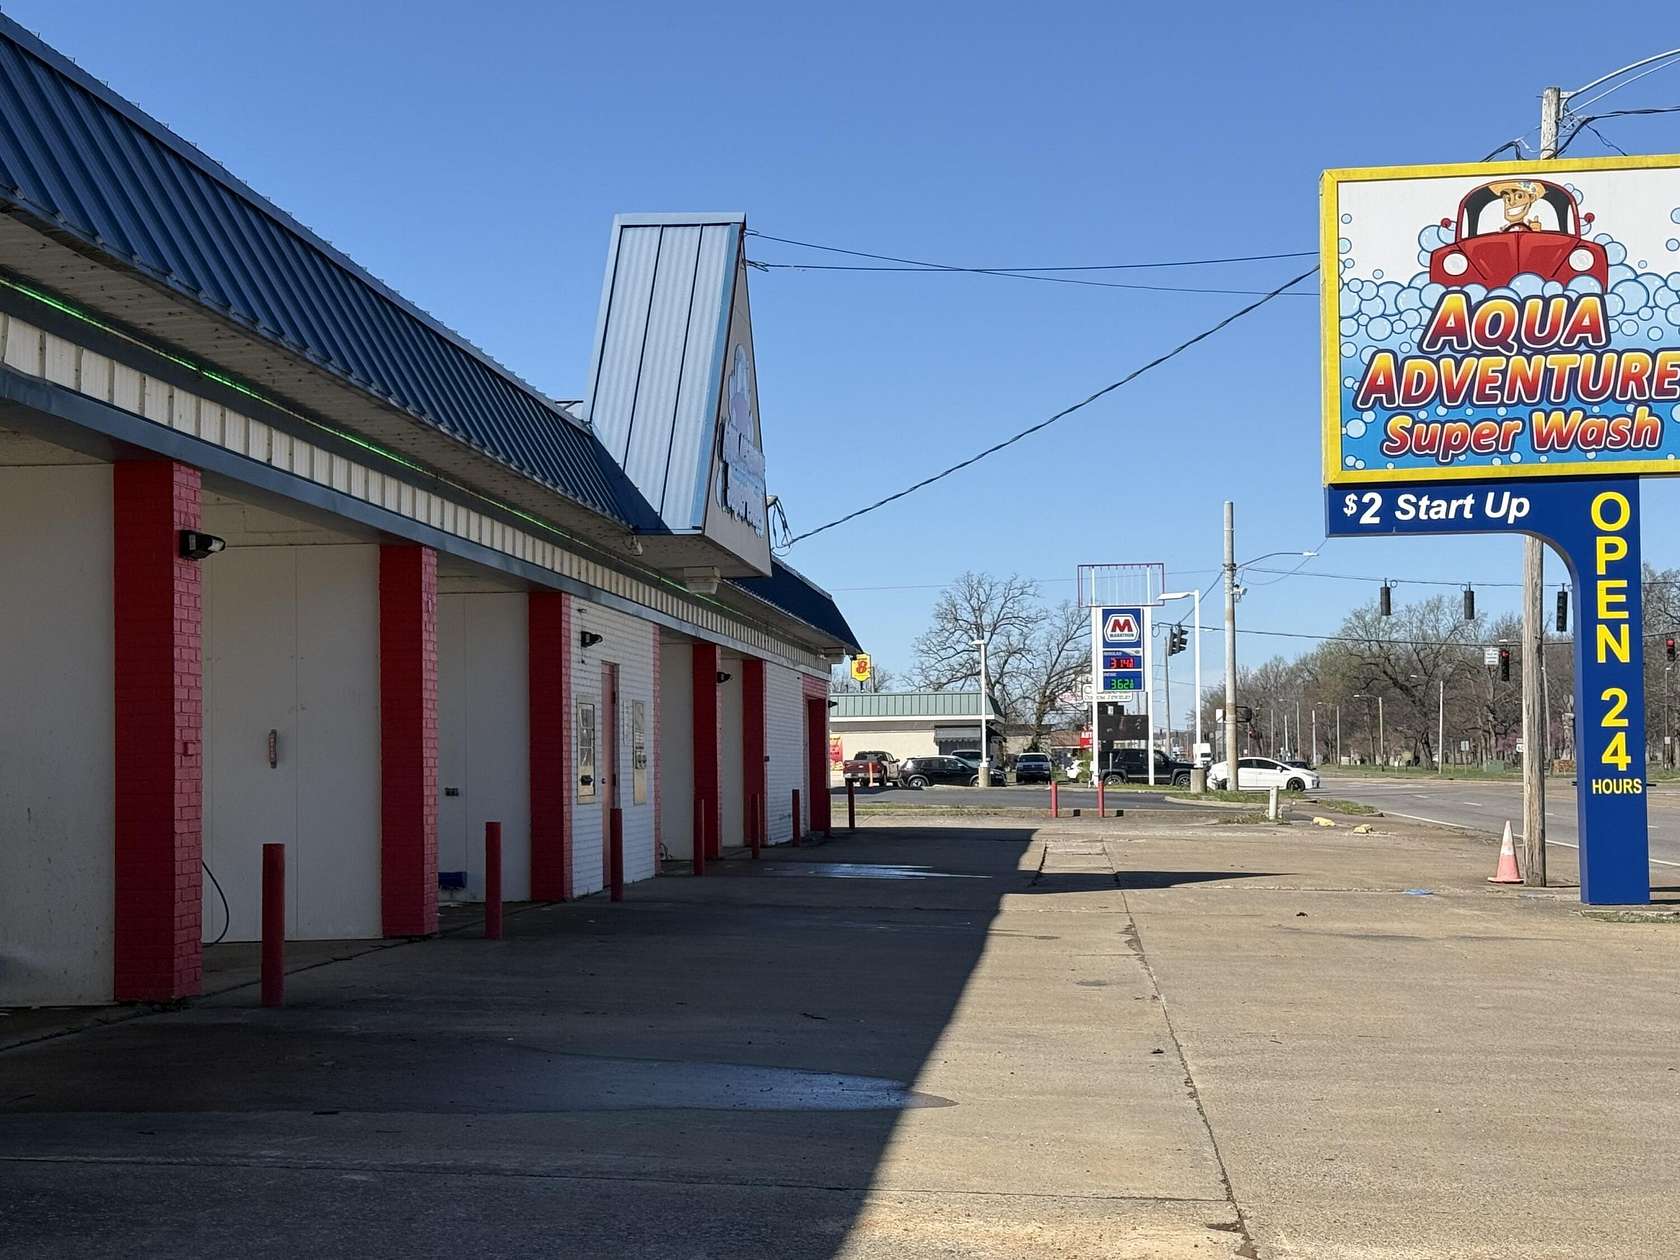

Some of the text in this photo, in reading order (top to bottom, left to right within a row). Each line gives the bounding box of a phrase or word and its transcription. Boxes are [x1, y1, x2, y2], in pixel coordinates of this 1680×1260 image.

[1423, 293, 1606, 354] AQUA
[1357, 350, 1680, 408] ADVENTURE
[1383, 406, 1661, 463] Super Wash
[1343, 491, 1530, 525] $2 Start Up
[1590, 491, 1631, 664] OPEN
[856, 660, 868, 674] 8
[1600, 687, 1632, 771] 24
[1592, 778, 1642, 795] HOURS
